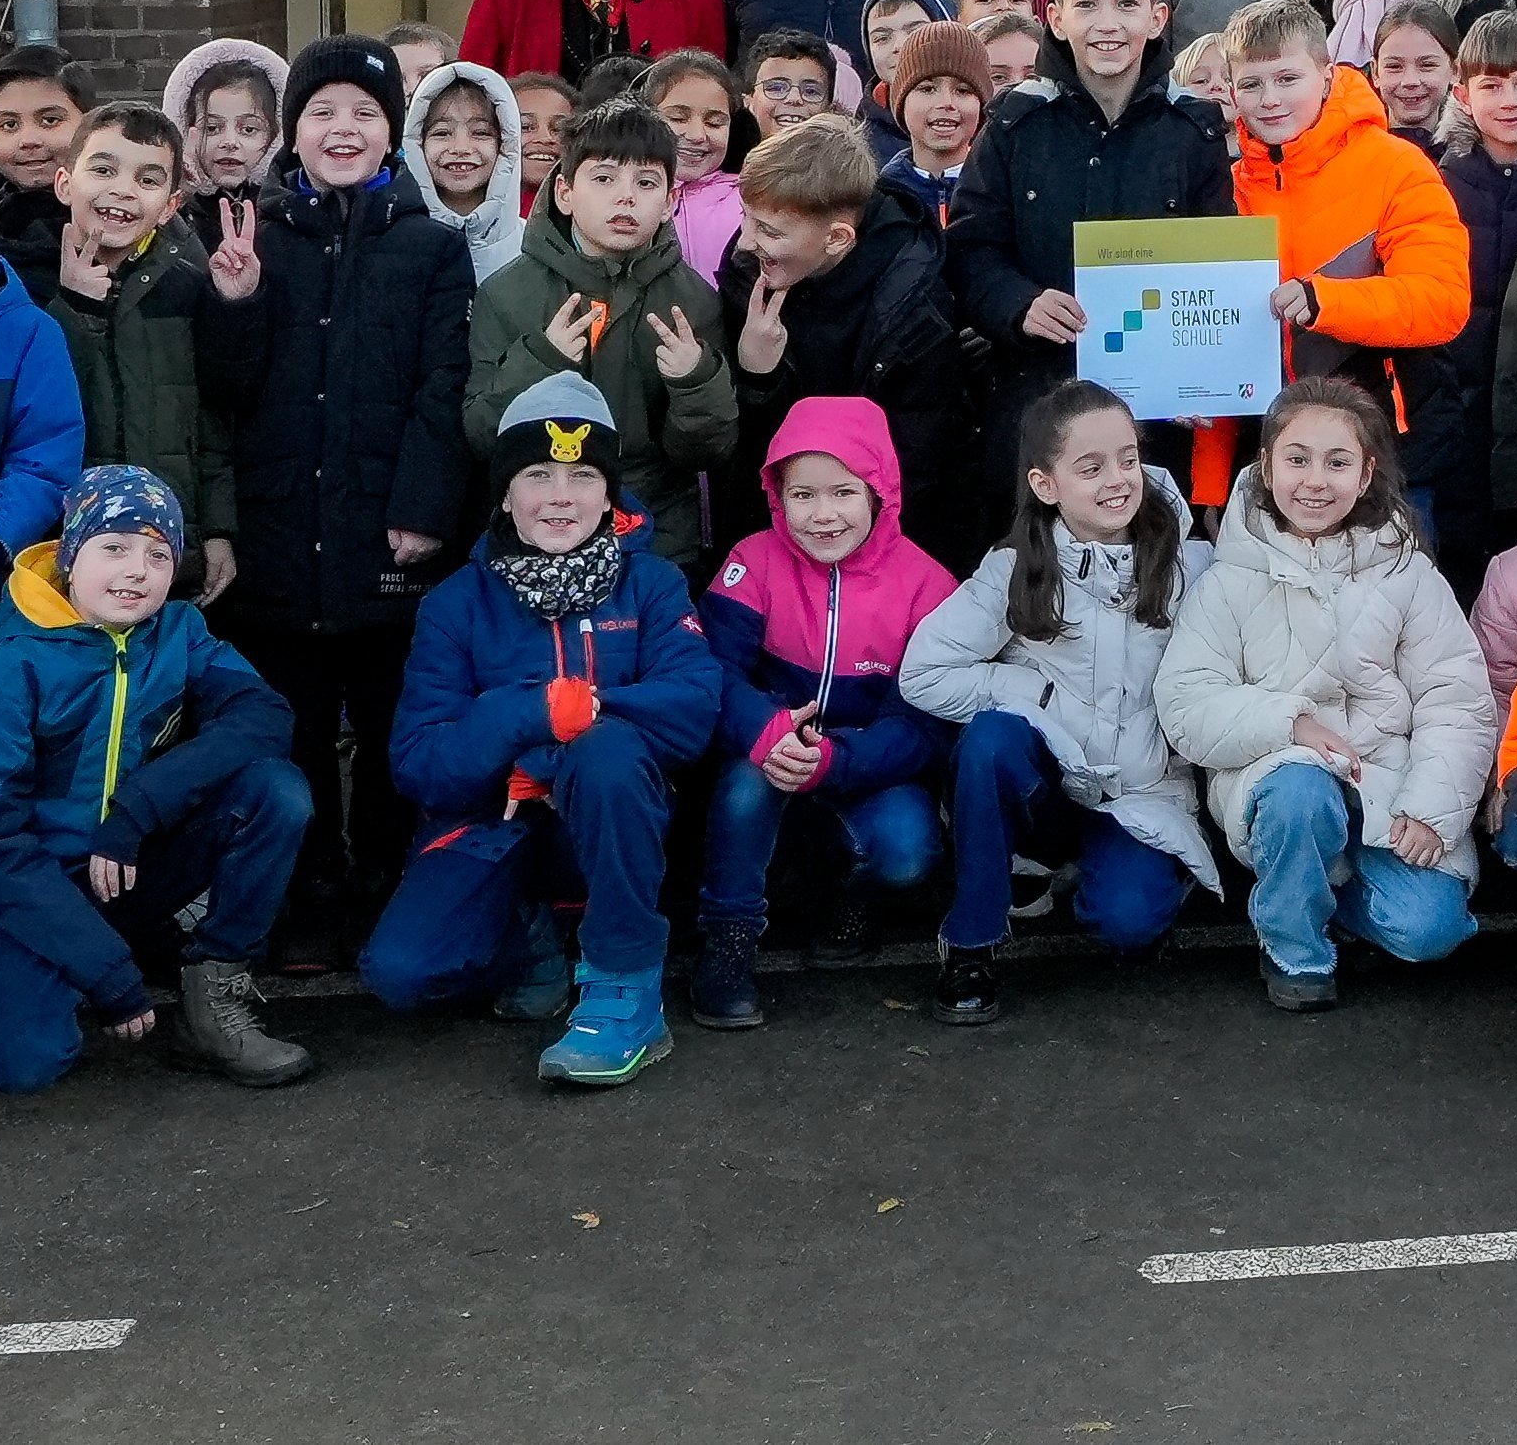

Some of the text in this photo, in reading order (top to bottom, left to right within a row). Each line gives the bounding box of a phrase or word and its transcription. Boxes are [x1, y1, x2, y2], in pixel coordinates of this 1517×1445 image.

[1098, 248, 1153, 259] Wir sind eine
[1171, 290, 1215, 307] START
[1171, 308, 1240, 327] CHANCEN
[1172, 329, 1222, 347] SCHULE
